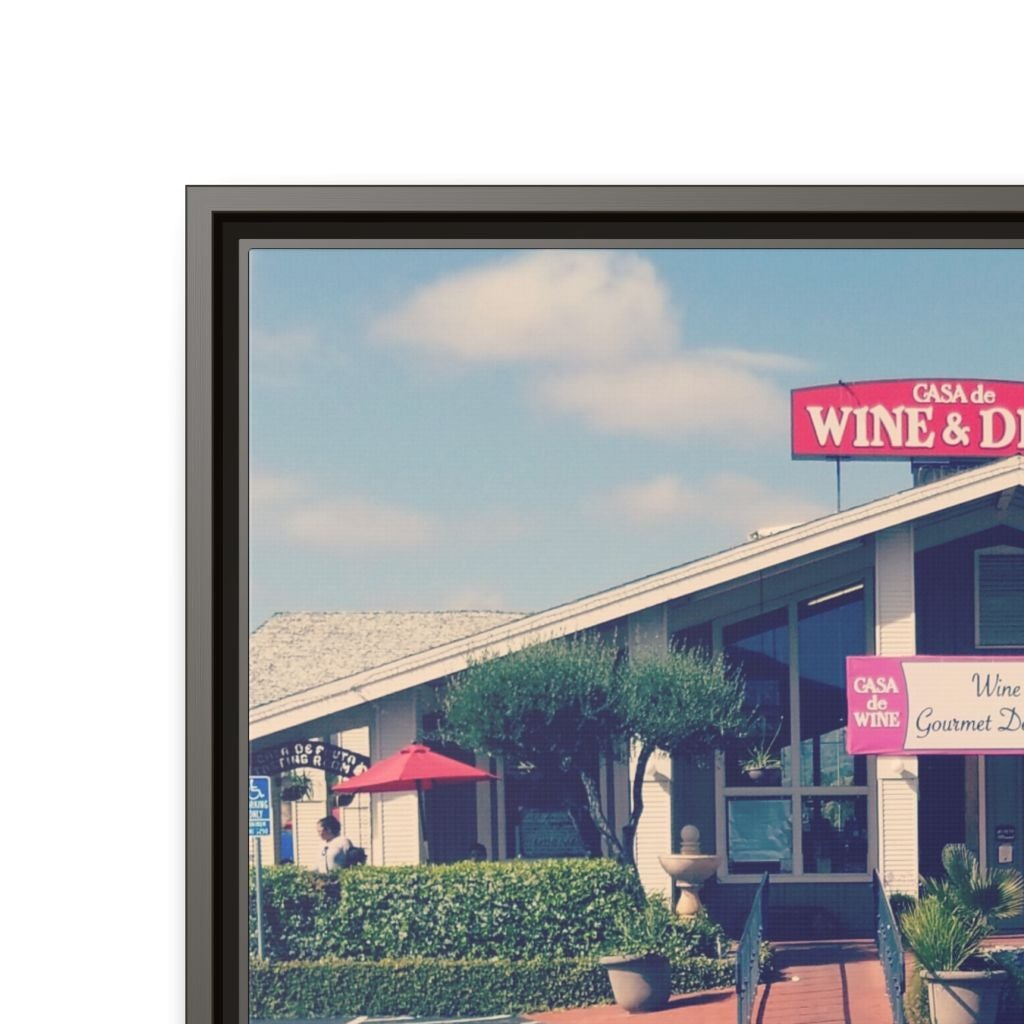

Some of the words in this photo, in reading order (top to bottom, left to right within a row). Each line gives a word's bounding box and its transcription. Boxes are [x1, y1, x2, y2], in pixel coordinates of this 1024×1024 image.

[913, 383, 969, 404] CASA
[970, 384, 996, 405] de
[806, 404, 935, 448] WINE
[942, 412, 970, 446] &
[853, 677, 899, 694] CASA
[972, 672, 1021, 698] Wine
[866, 695, 887, 711] de
[853, 711, 900, 728] WINE
[915, 707, 993, 739] Gourmet
[254, 754, 309, 775] TATING
[313, 755, 351, 774] ROM
[315, 744, 356, 765] FUTA
